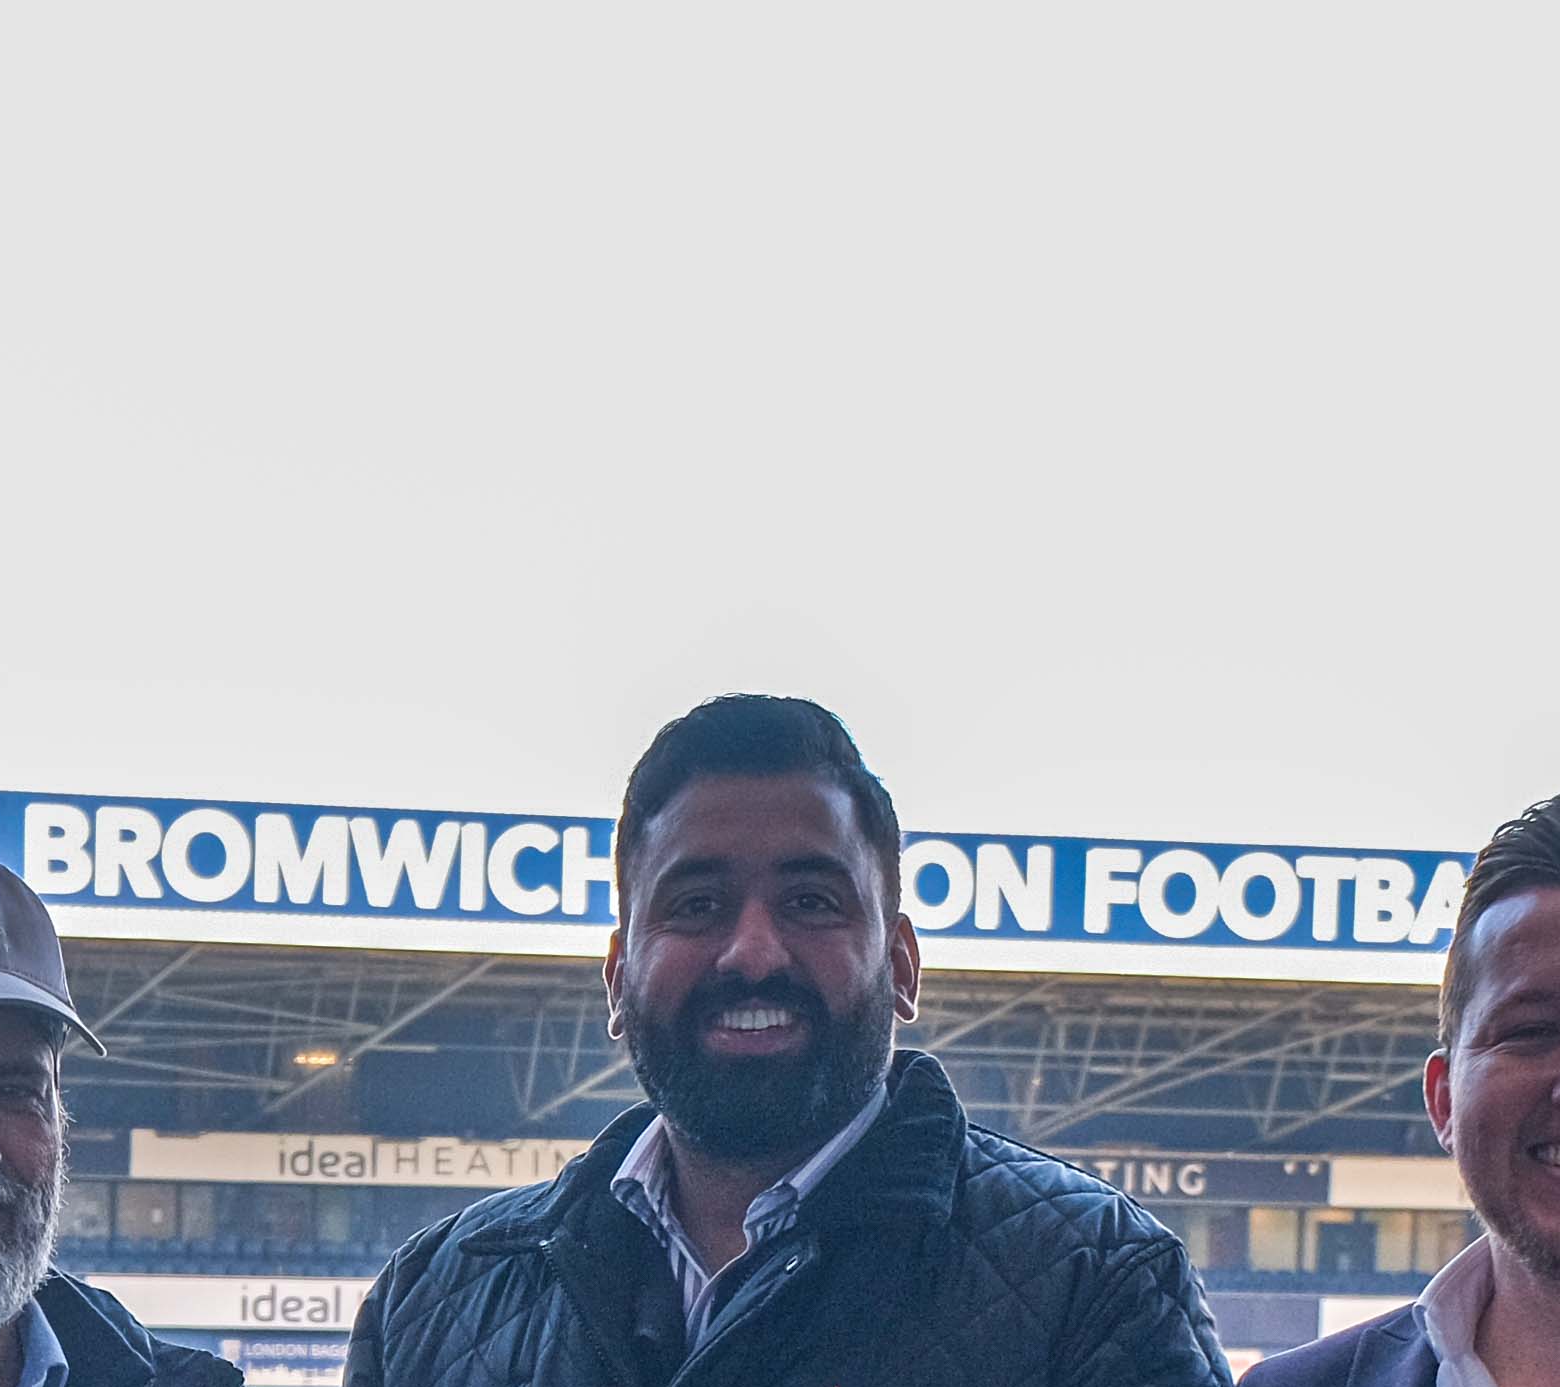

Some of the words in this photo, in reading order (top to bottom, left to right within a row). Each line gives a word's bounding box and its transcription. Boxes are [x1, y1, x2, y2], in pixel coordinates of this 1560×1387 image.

[24, 803, 618, 916] BROMWICH
[279, 1140, 378, 1178] ideal
[241, 1285, 341, 1323] ideal
